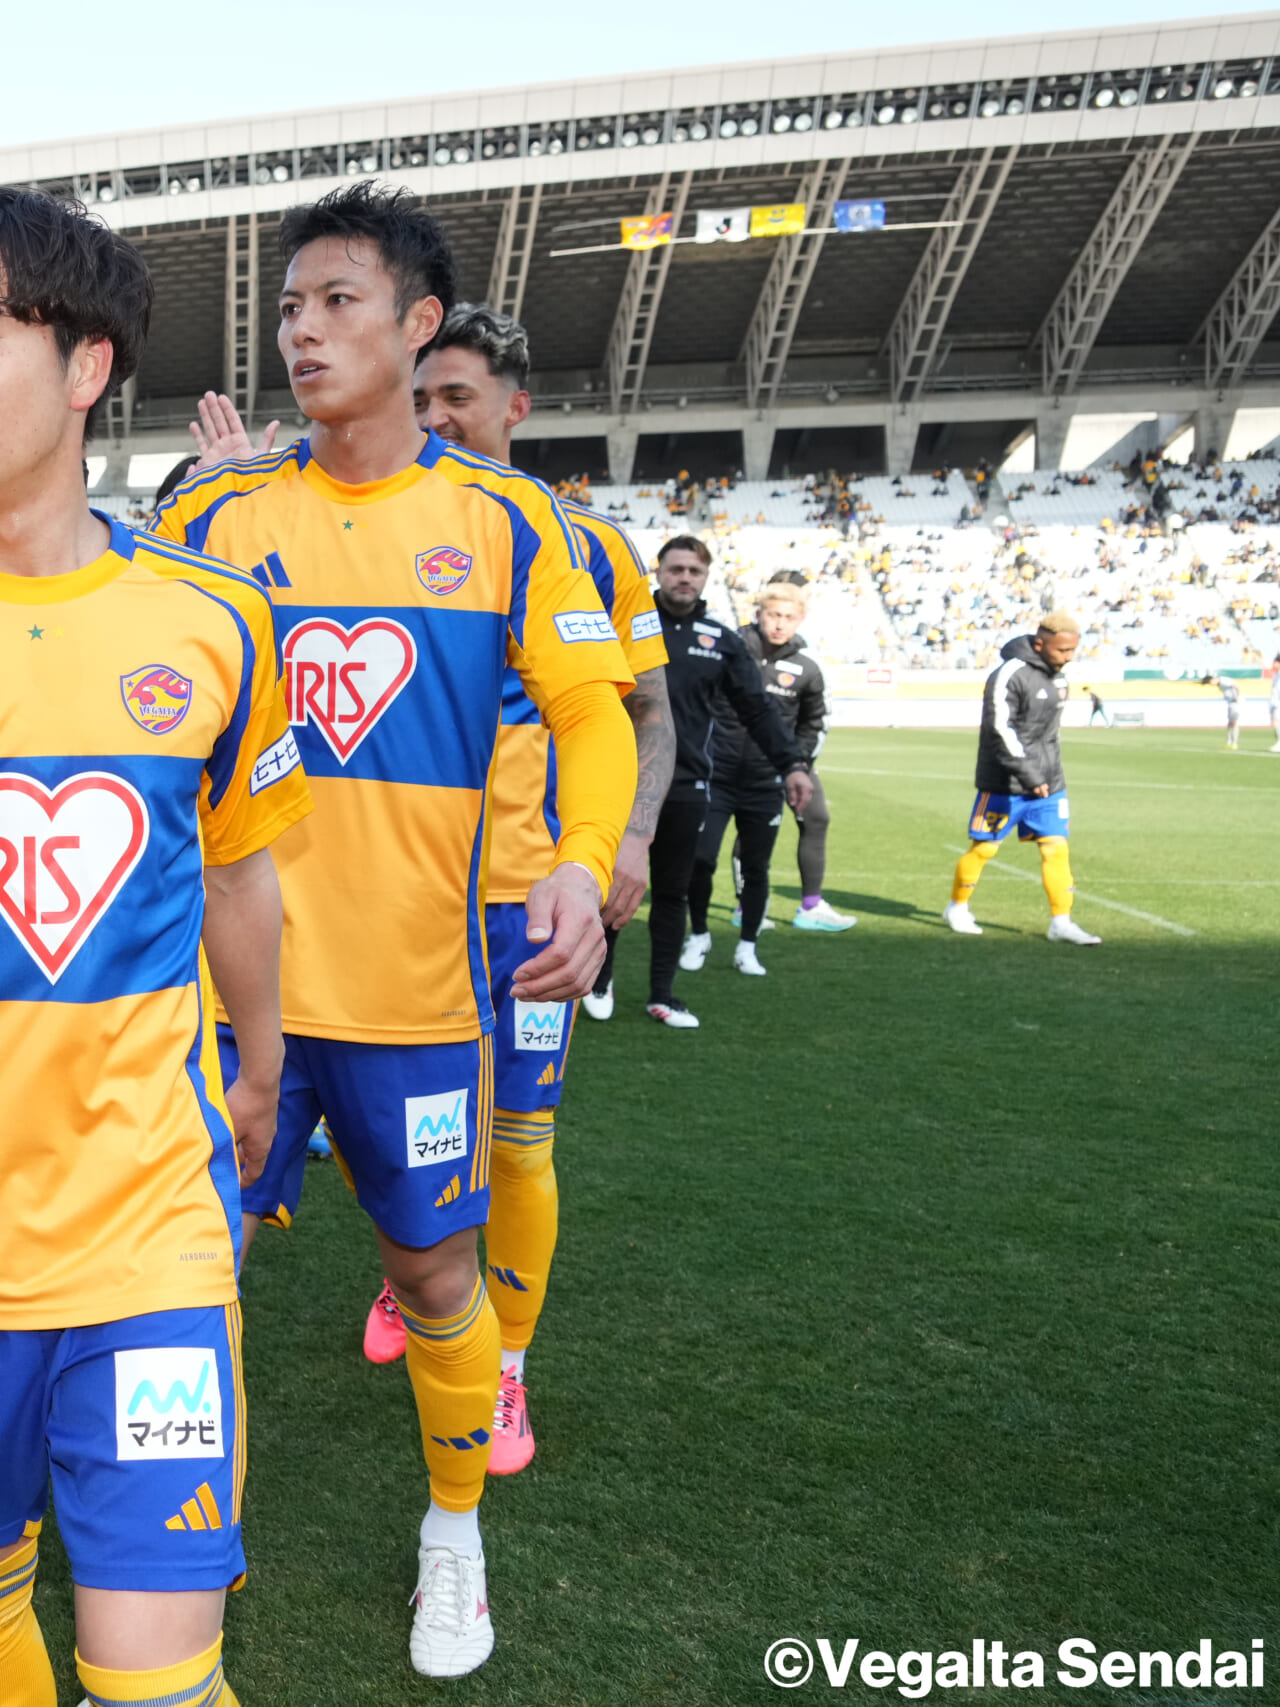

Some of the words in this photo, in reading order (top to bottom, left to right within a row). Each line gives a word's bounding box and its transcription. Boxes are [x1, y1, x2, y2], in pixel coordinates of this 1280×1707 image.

[563, 618, 617, 635] 七十七
[284, 661, 367, 723] IRIS
[254, 740, 298, 782] 七十七
[982, 812, 1009, 833] 27
[521, 1031, 559, 1045] マイナビ
[414, 1134, 462, 1158] マイナビ
[127, 1420, 216, 1447] マイナビ
